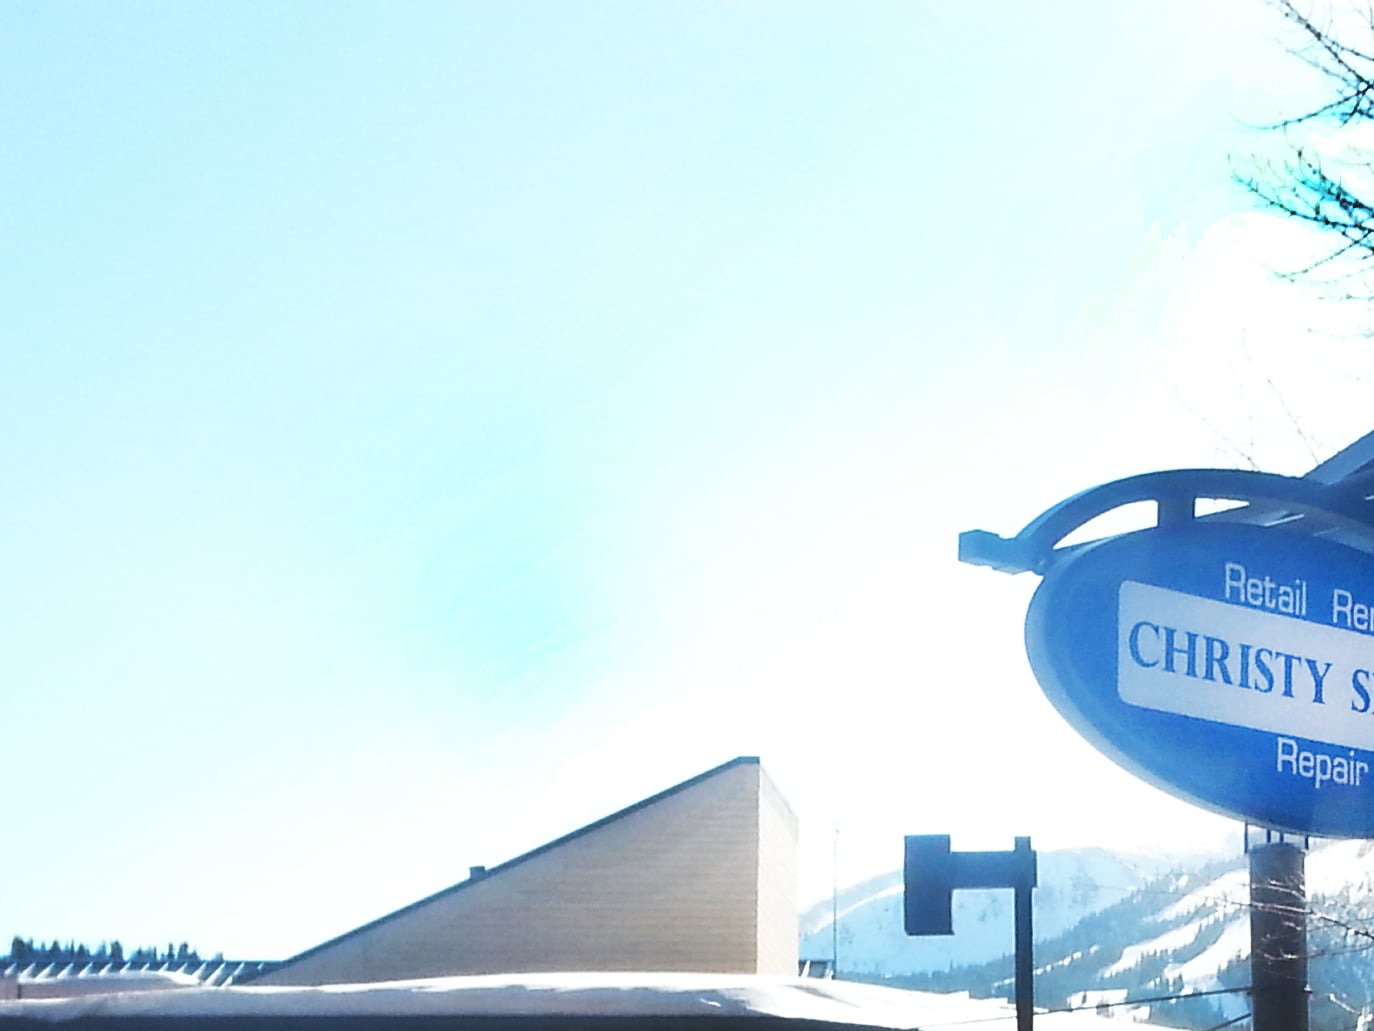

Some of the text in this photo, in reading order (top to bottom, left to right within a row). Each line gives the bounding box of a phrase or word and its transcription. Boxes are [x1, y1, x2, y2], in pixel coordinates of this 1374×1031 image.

[1225, 562, 1307, 618] Retail
[1128, 620, 1334, 705] CHRISTY
[1276, 736, 1370, 788] Repair
